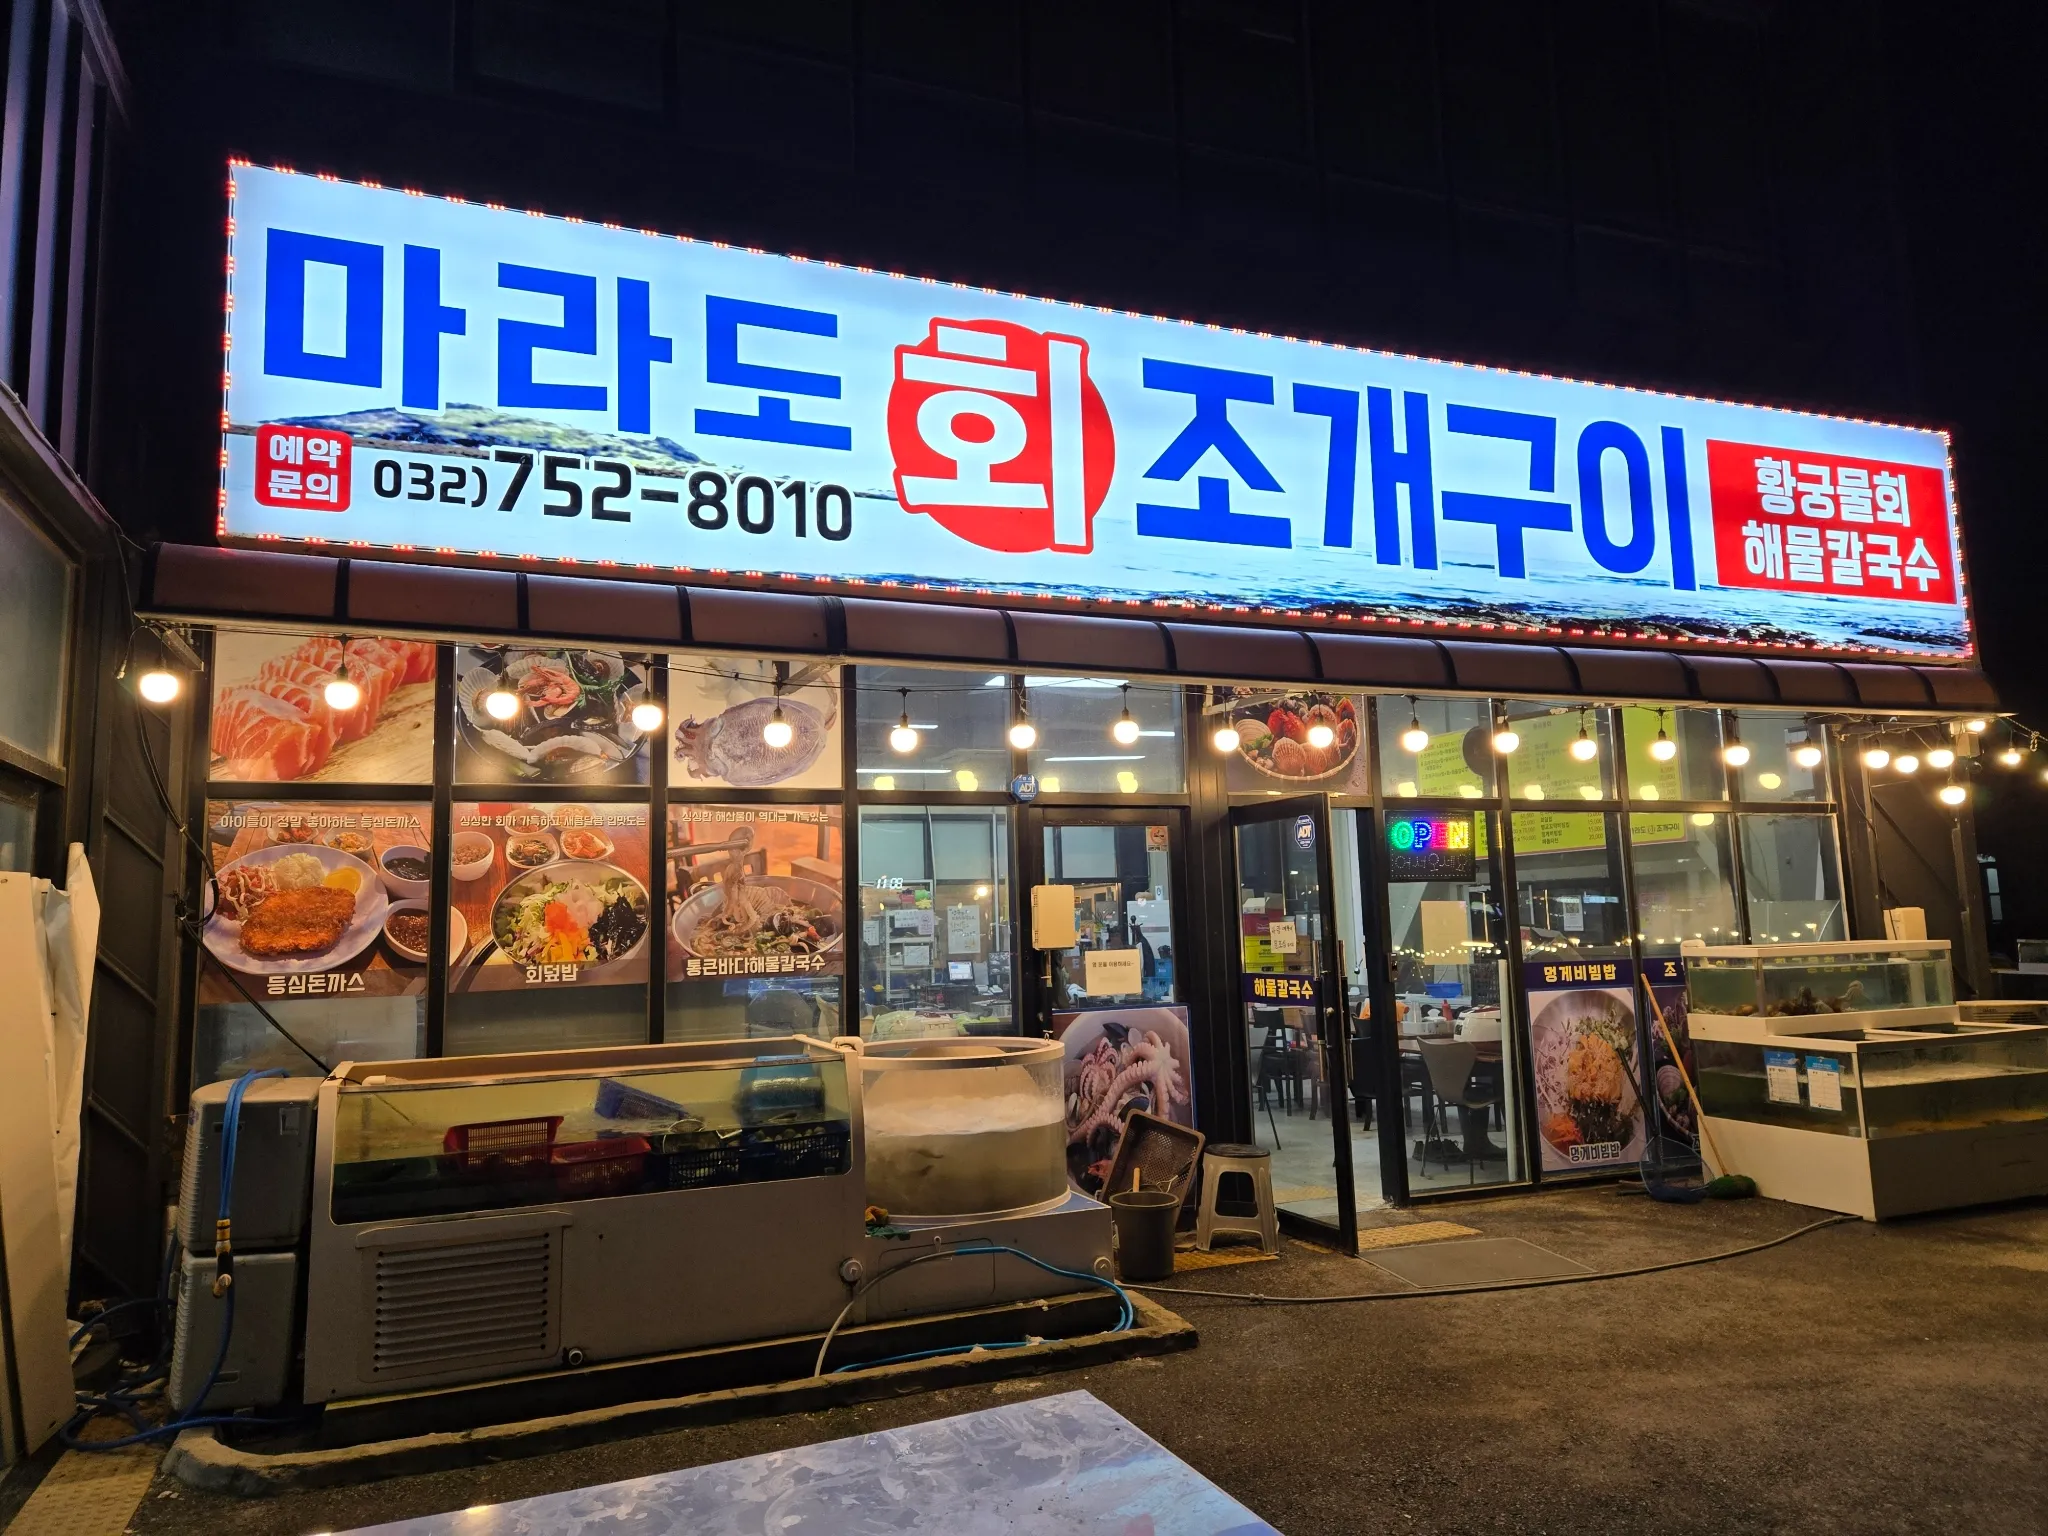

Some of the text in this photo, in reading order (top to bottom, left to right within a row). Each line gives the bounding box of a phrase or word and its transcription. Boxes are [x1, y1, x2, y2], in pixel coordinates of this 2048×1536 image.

[264, 228, 1697, 591] 마라도 회 조개구이
[269, 433, 342, 468] 예약
[267, 470, 339, 504] 문의
[373, 450, 853, 542] 032)752-8010
[1754, 456, 1911, 527] 황궁물회
[1742, 519, 1941, 593] 해물칼국수
[1019, 783, 1035, 793] ADT
[220, 815, 421, 829] 아이들이 정말 좋아하는 등심돈까스
[460, 815, 646, 827] 싱싱한 회가 가득하고 새콤달콤 입맛도는
[681, 811, 829, 823] 싱싱한 해산물이 역대급 가득있는
[1298, 825, 1312, 839] ADT
[1391, 821, 1469, 849] OPEN
[1395, 853, 1468, 872] 어서오세요
[525, 963, 578, 985] 회덮밥
[686, 954, 826, 977] 통큰바다해물칼국수
[1544, 963, 1616, 983] 멍게비빔밥
[266, 972, 365, 995] 등심돈까스
[1254, 978, 1314, 999] 해물칼국수
[1570, 1143, 1621, 1162] 멍게비빔밥
